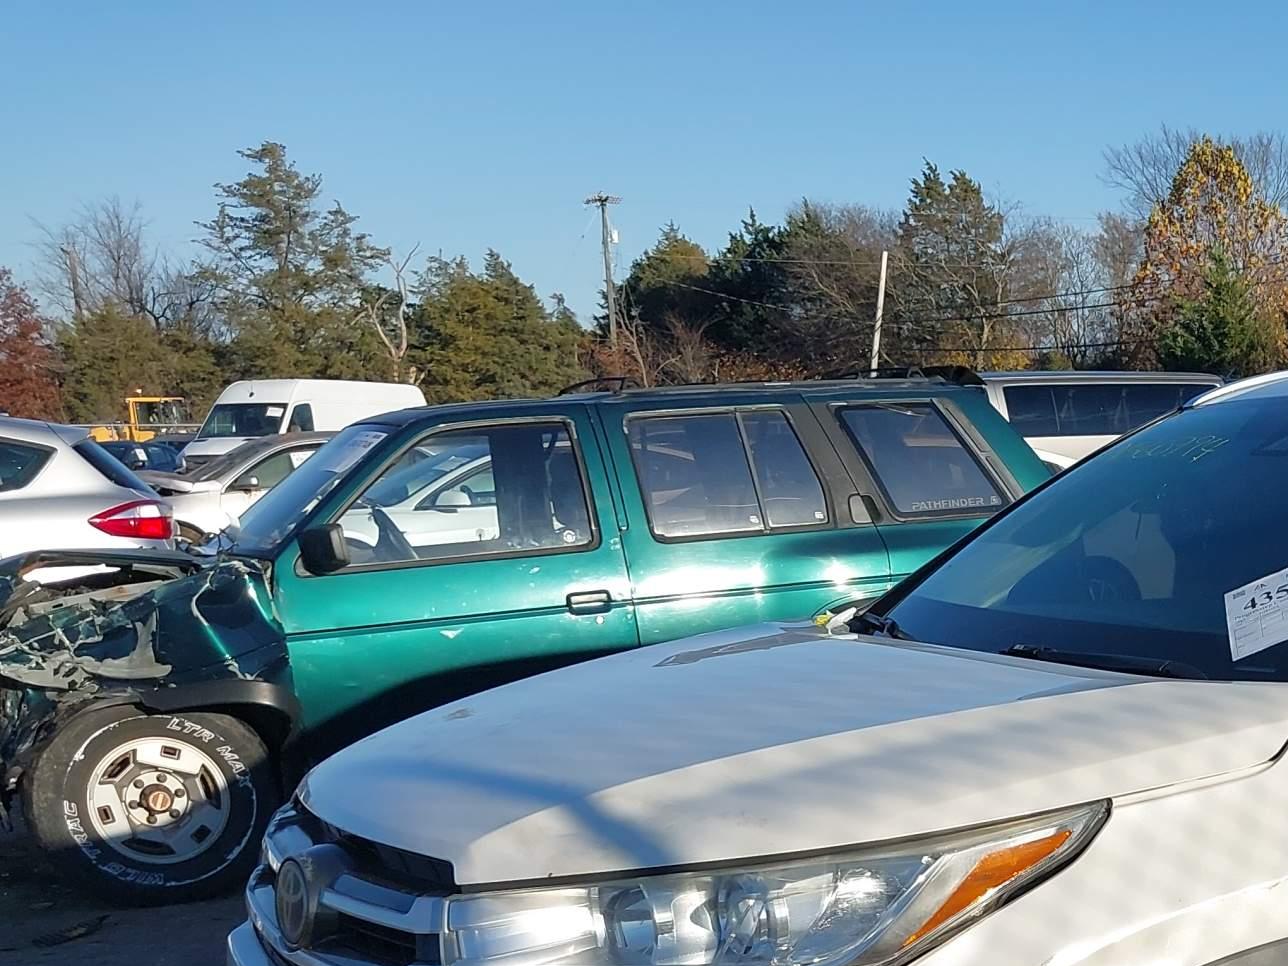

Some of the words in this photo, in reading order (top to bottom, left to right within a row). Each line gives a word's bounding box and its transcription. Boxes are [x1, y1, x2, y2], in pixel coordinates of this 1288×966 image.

[911, 497, 985, 511] PATHFINDER
[166, 716, 216, 743] LTR
[216, 745, 252, 788] MAX
[63, 800, 102, 863] TRAC
